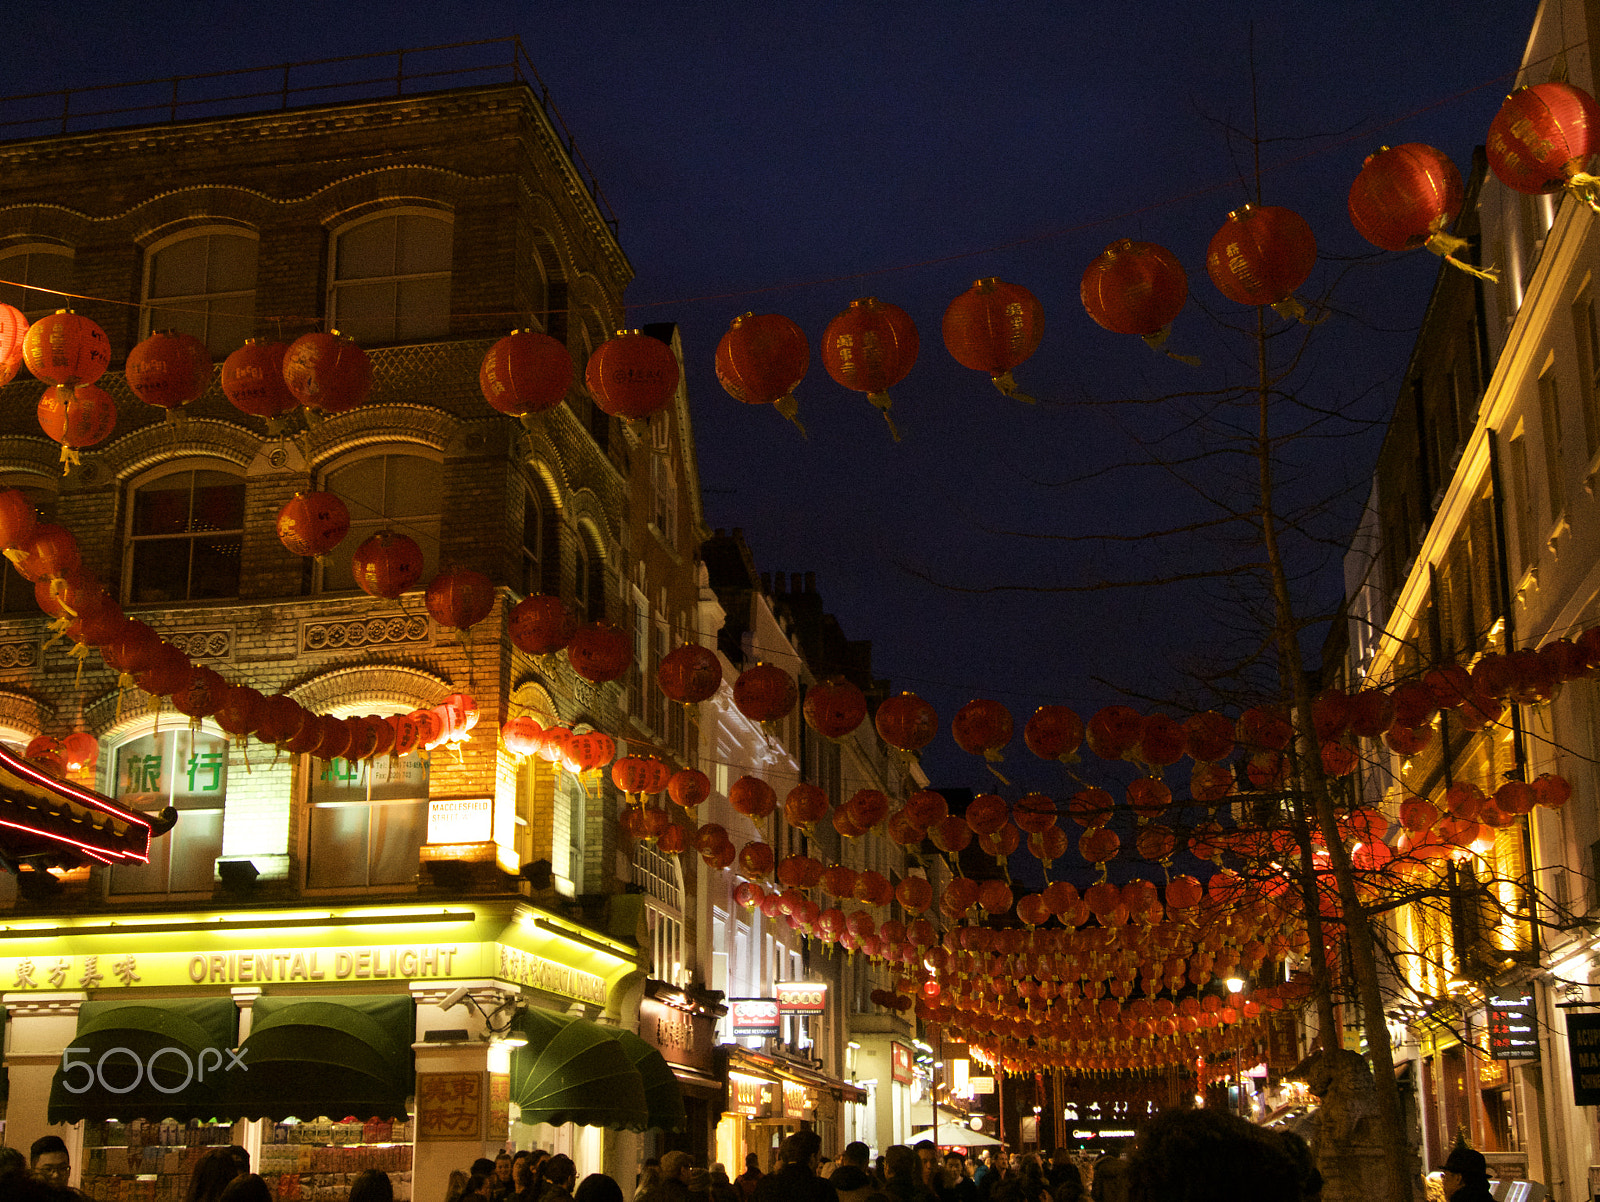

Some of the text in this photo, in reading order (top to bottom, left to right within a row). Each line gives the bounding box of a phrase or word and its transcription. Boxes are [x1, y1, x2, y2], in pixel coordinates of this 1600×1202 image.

[432, 802, 488, 812] MACCLESFIELD
[432, 813, 459, 822] STREET
[13, 955, 142, 990] 東方美味
[188, 947, 458, 982] ORIENTAL DELIGHT
